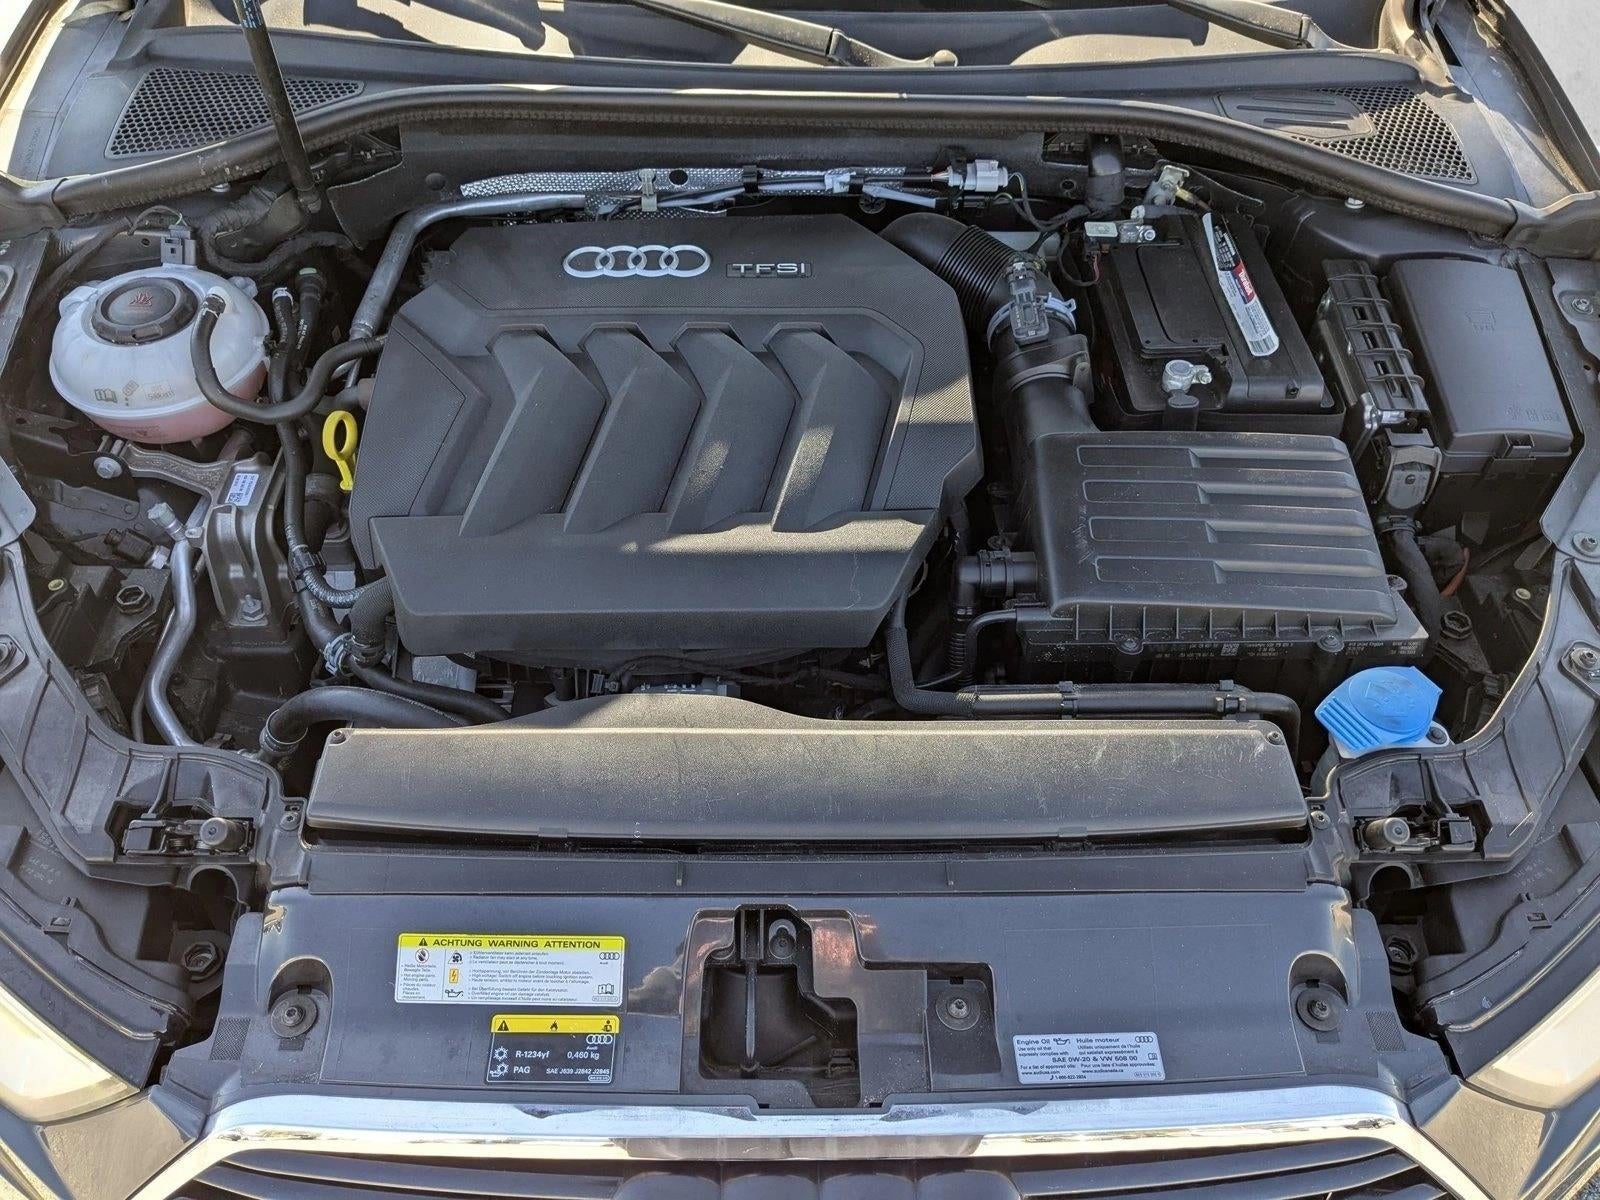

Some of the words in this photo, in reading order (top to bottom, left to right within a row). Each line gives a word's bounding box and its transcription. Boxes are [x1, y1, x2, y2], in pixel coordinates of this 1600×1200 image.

[732, 262, 804, 274] TFSI
[488, 940, 538, 948] WARNING
[515, 1050, 550, 1059] R-1234yf
[590, 1051, 600, 1060] kg
